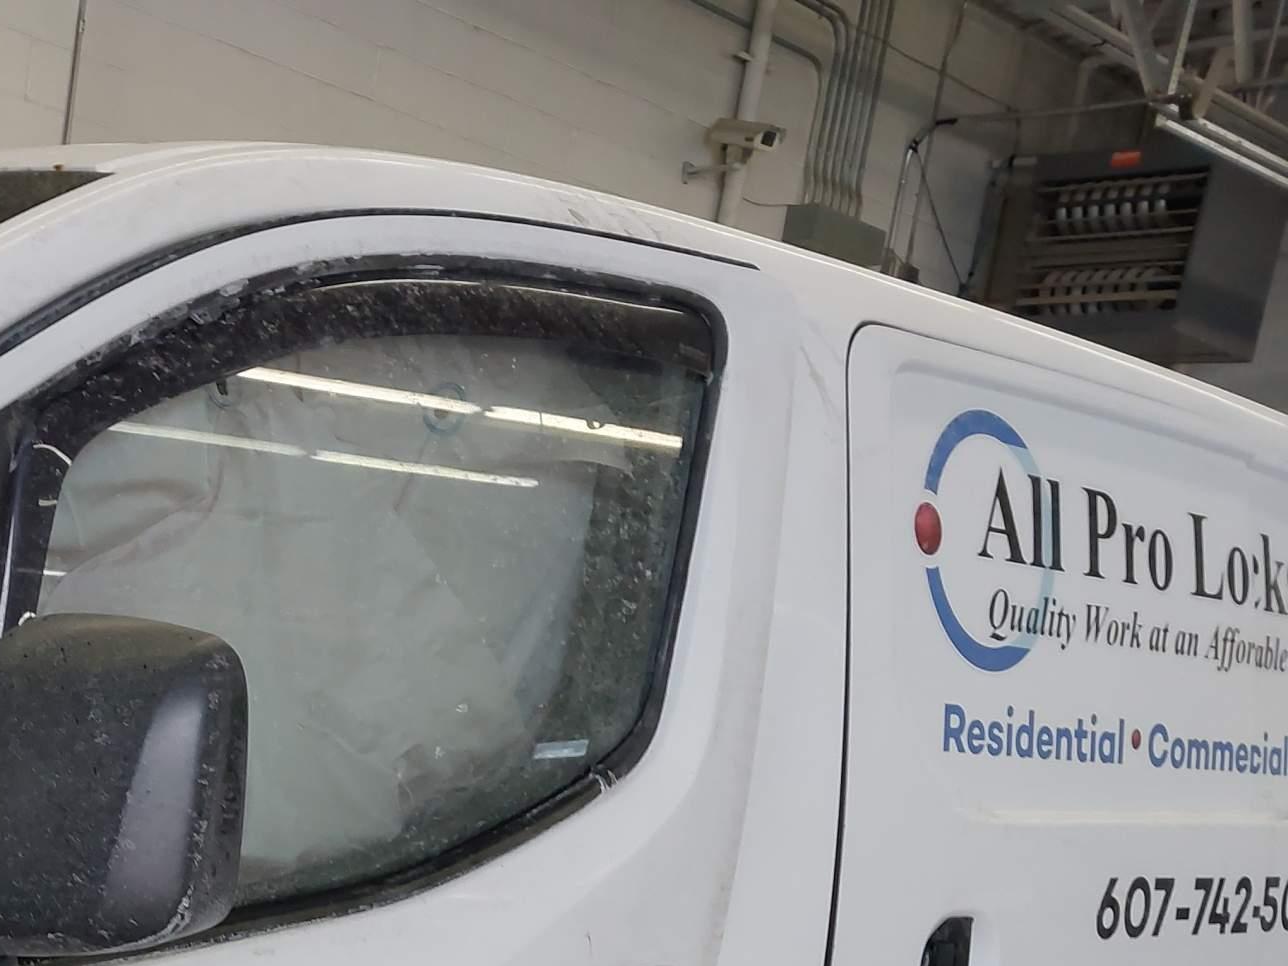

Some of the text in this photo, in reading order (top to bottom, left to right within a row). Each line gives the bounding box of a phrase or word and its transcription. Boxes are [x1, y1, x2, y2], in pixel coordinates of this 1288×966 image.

[977, 465, 1065, 572] All
[1081, 486, 1173, 591] Pro
[989, 588, 1076, 651] Quality
[1086, 603, 1142, 649] Work
[1149, 622, 1169, 653] at
[1175, 630, 1198, 657] an
[943, 702, 1125, 764] Residential
